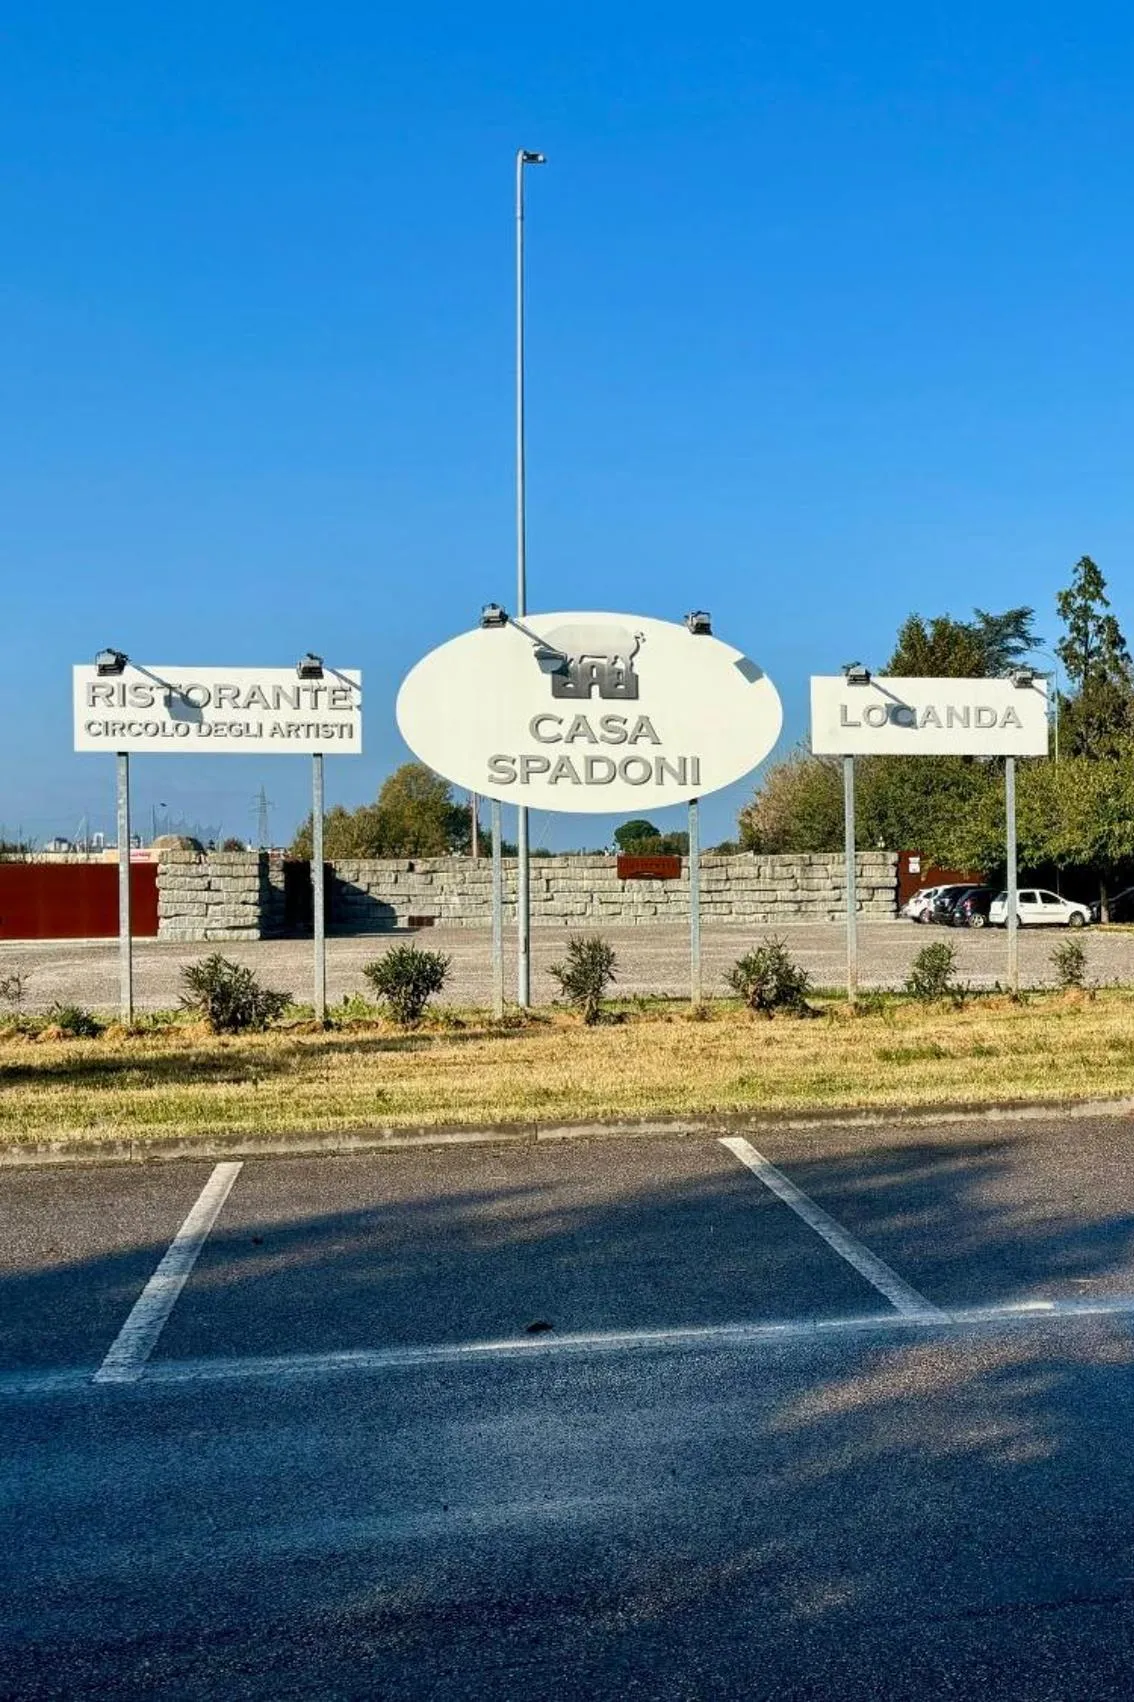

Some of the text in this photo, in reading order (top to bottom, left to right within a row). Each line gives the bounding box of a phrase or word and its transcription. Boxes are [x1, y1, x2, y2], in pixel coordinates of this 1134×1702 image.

[86, 682, 353, 711] RISTORANTE
[84, 719, 354, 740] CIRCOLO DEGLI ARTISTI
[528, 713, 662, 745] CASA
[840, 704, 1023, 729] LOCANDA
[487, 755, 702, 786] SPADONI
